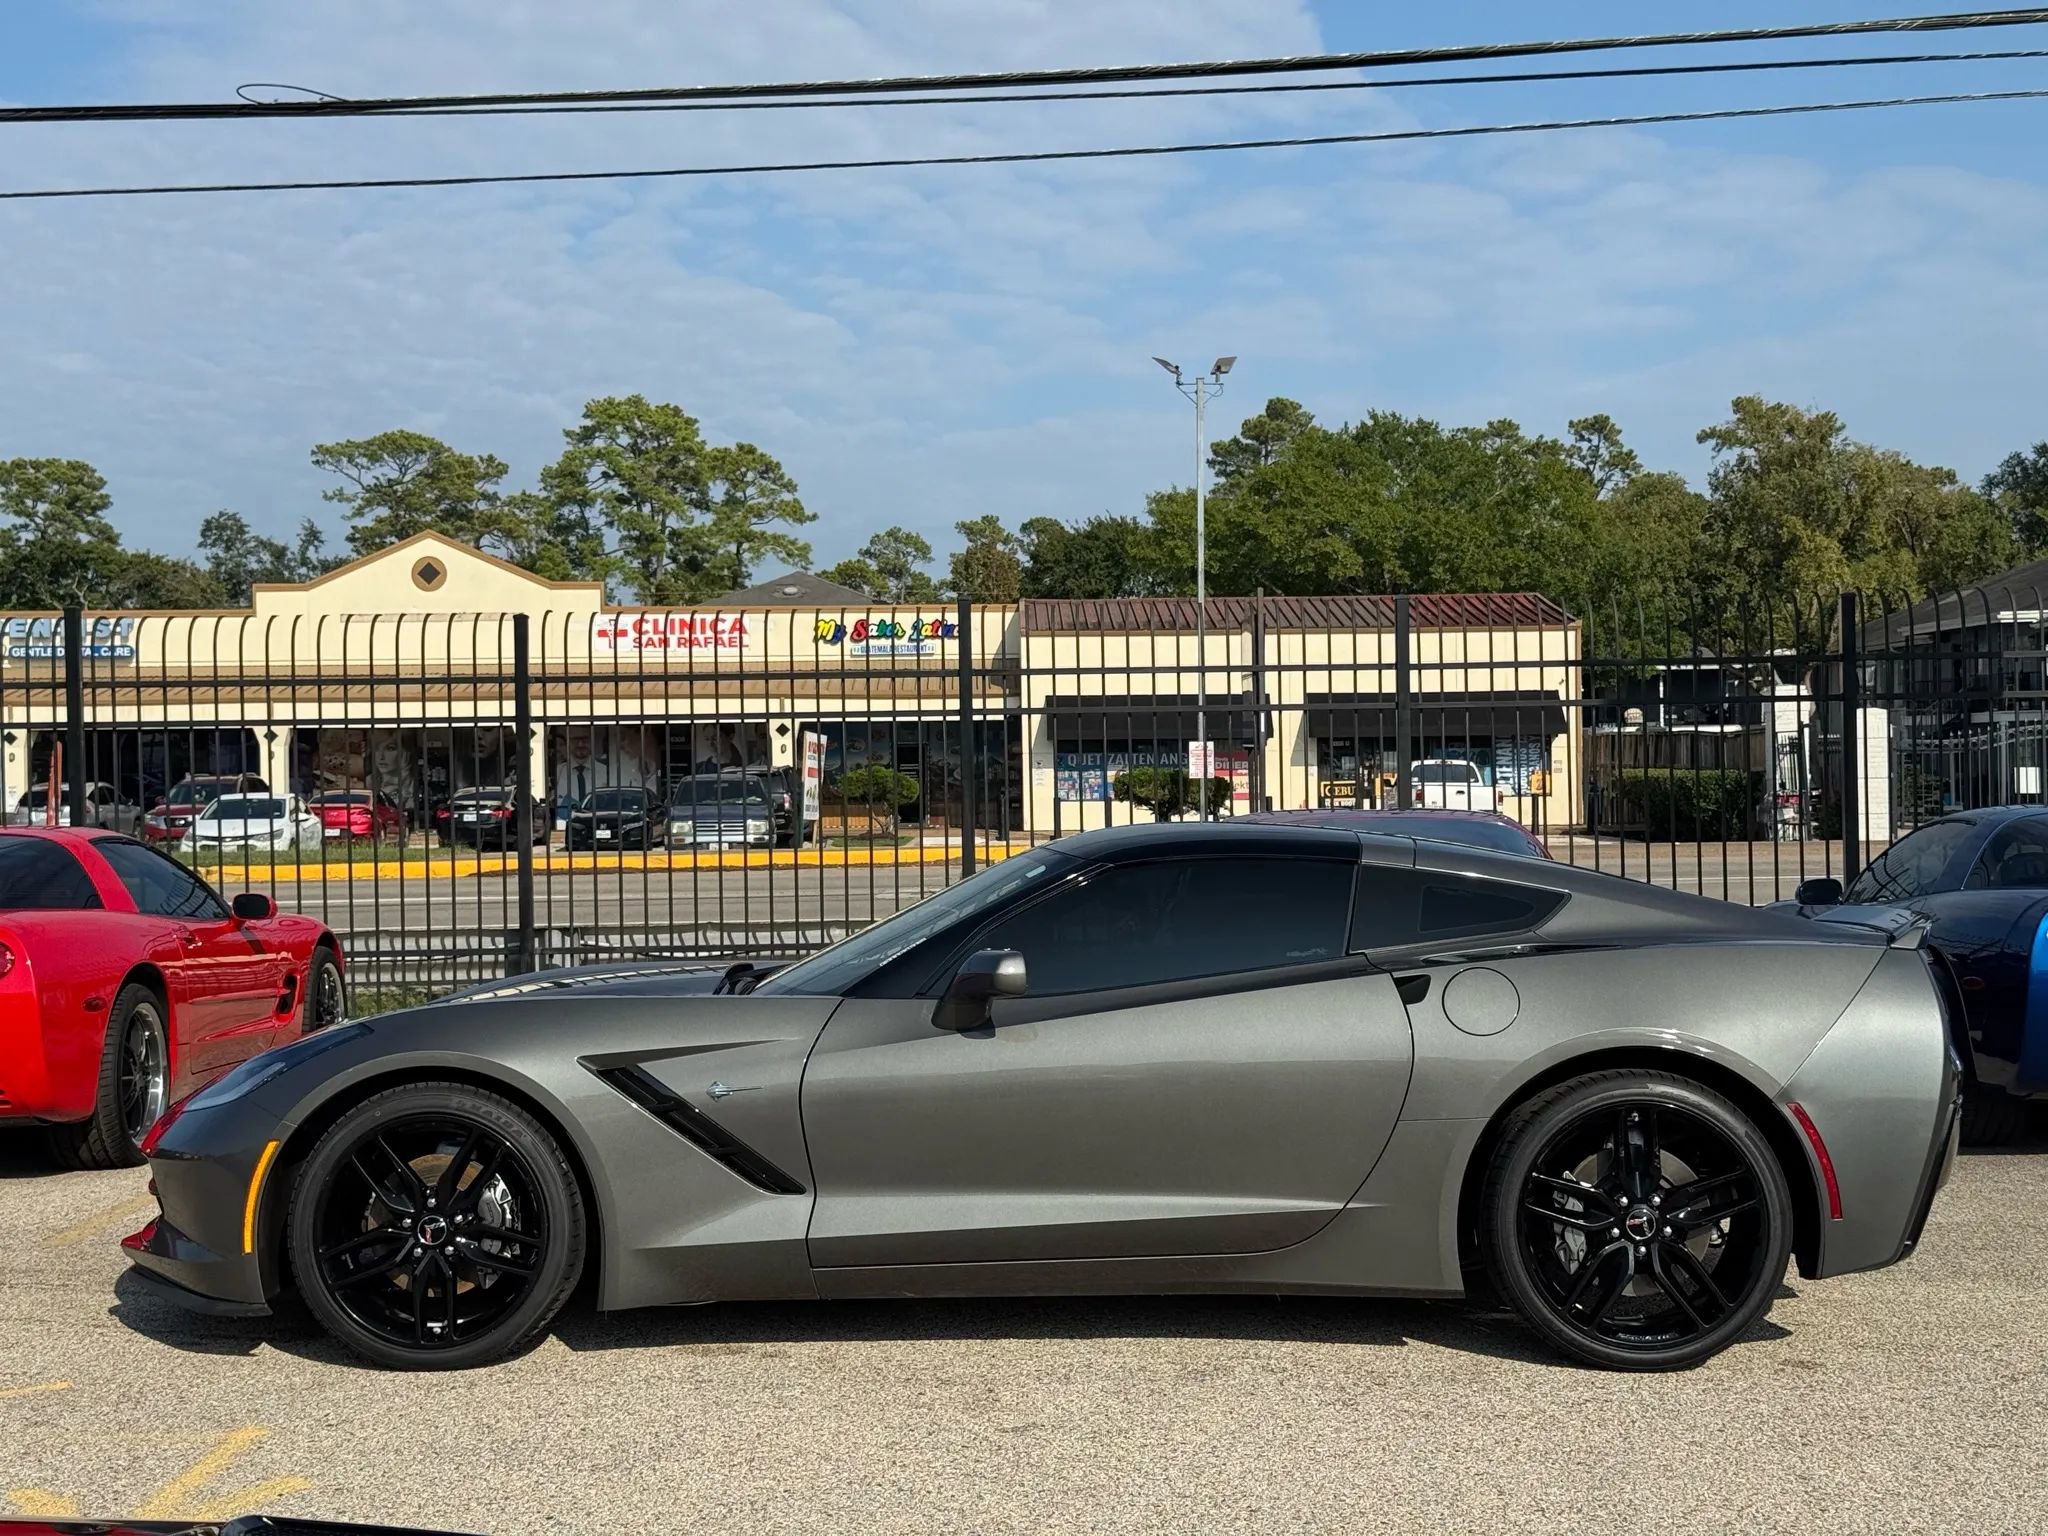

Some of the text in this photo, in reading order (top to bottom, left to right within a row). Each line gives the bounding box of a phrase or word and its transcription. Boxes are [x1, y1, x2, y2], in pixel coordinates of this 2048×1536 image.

[632, 617, 748, 635] CLINICA
[813, 618, 846, 642] My
[850, 618, 905, 640] Sabor
[633, 636, 749, 648] SAN RAFAEL
[11, 647, 53, 657] GENTLE
[100, 647, 131, 657] CARE
